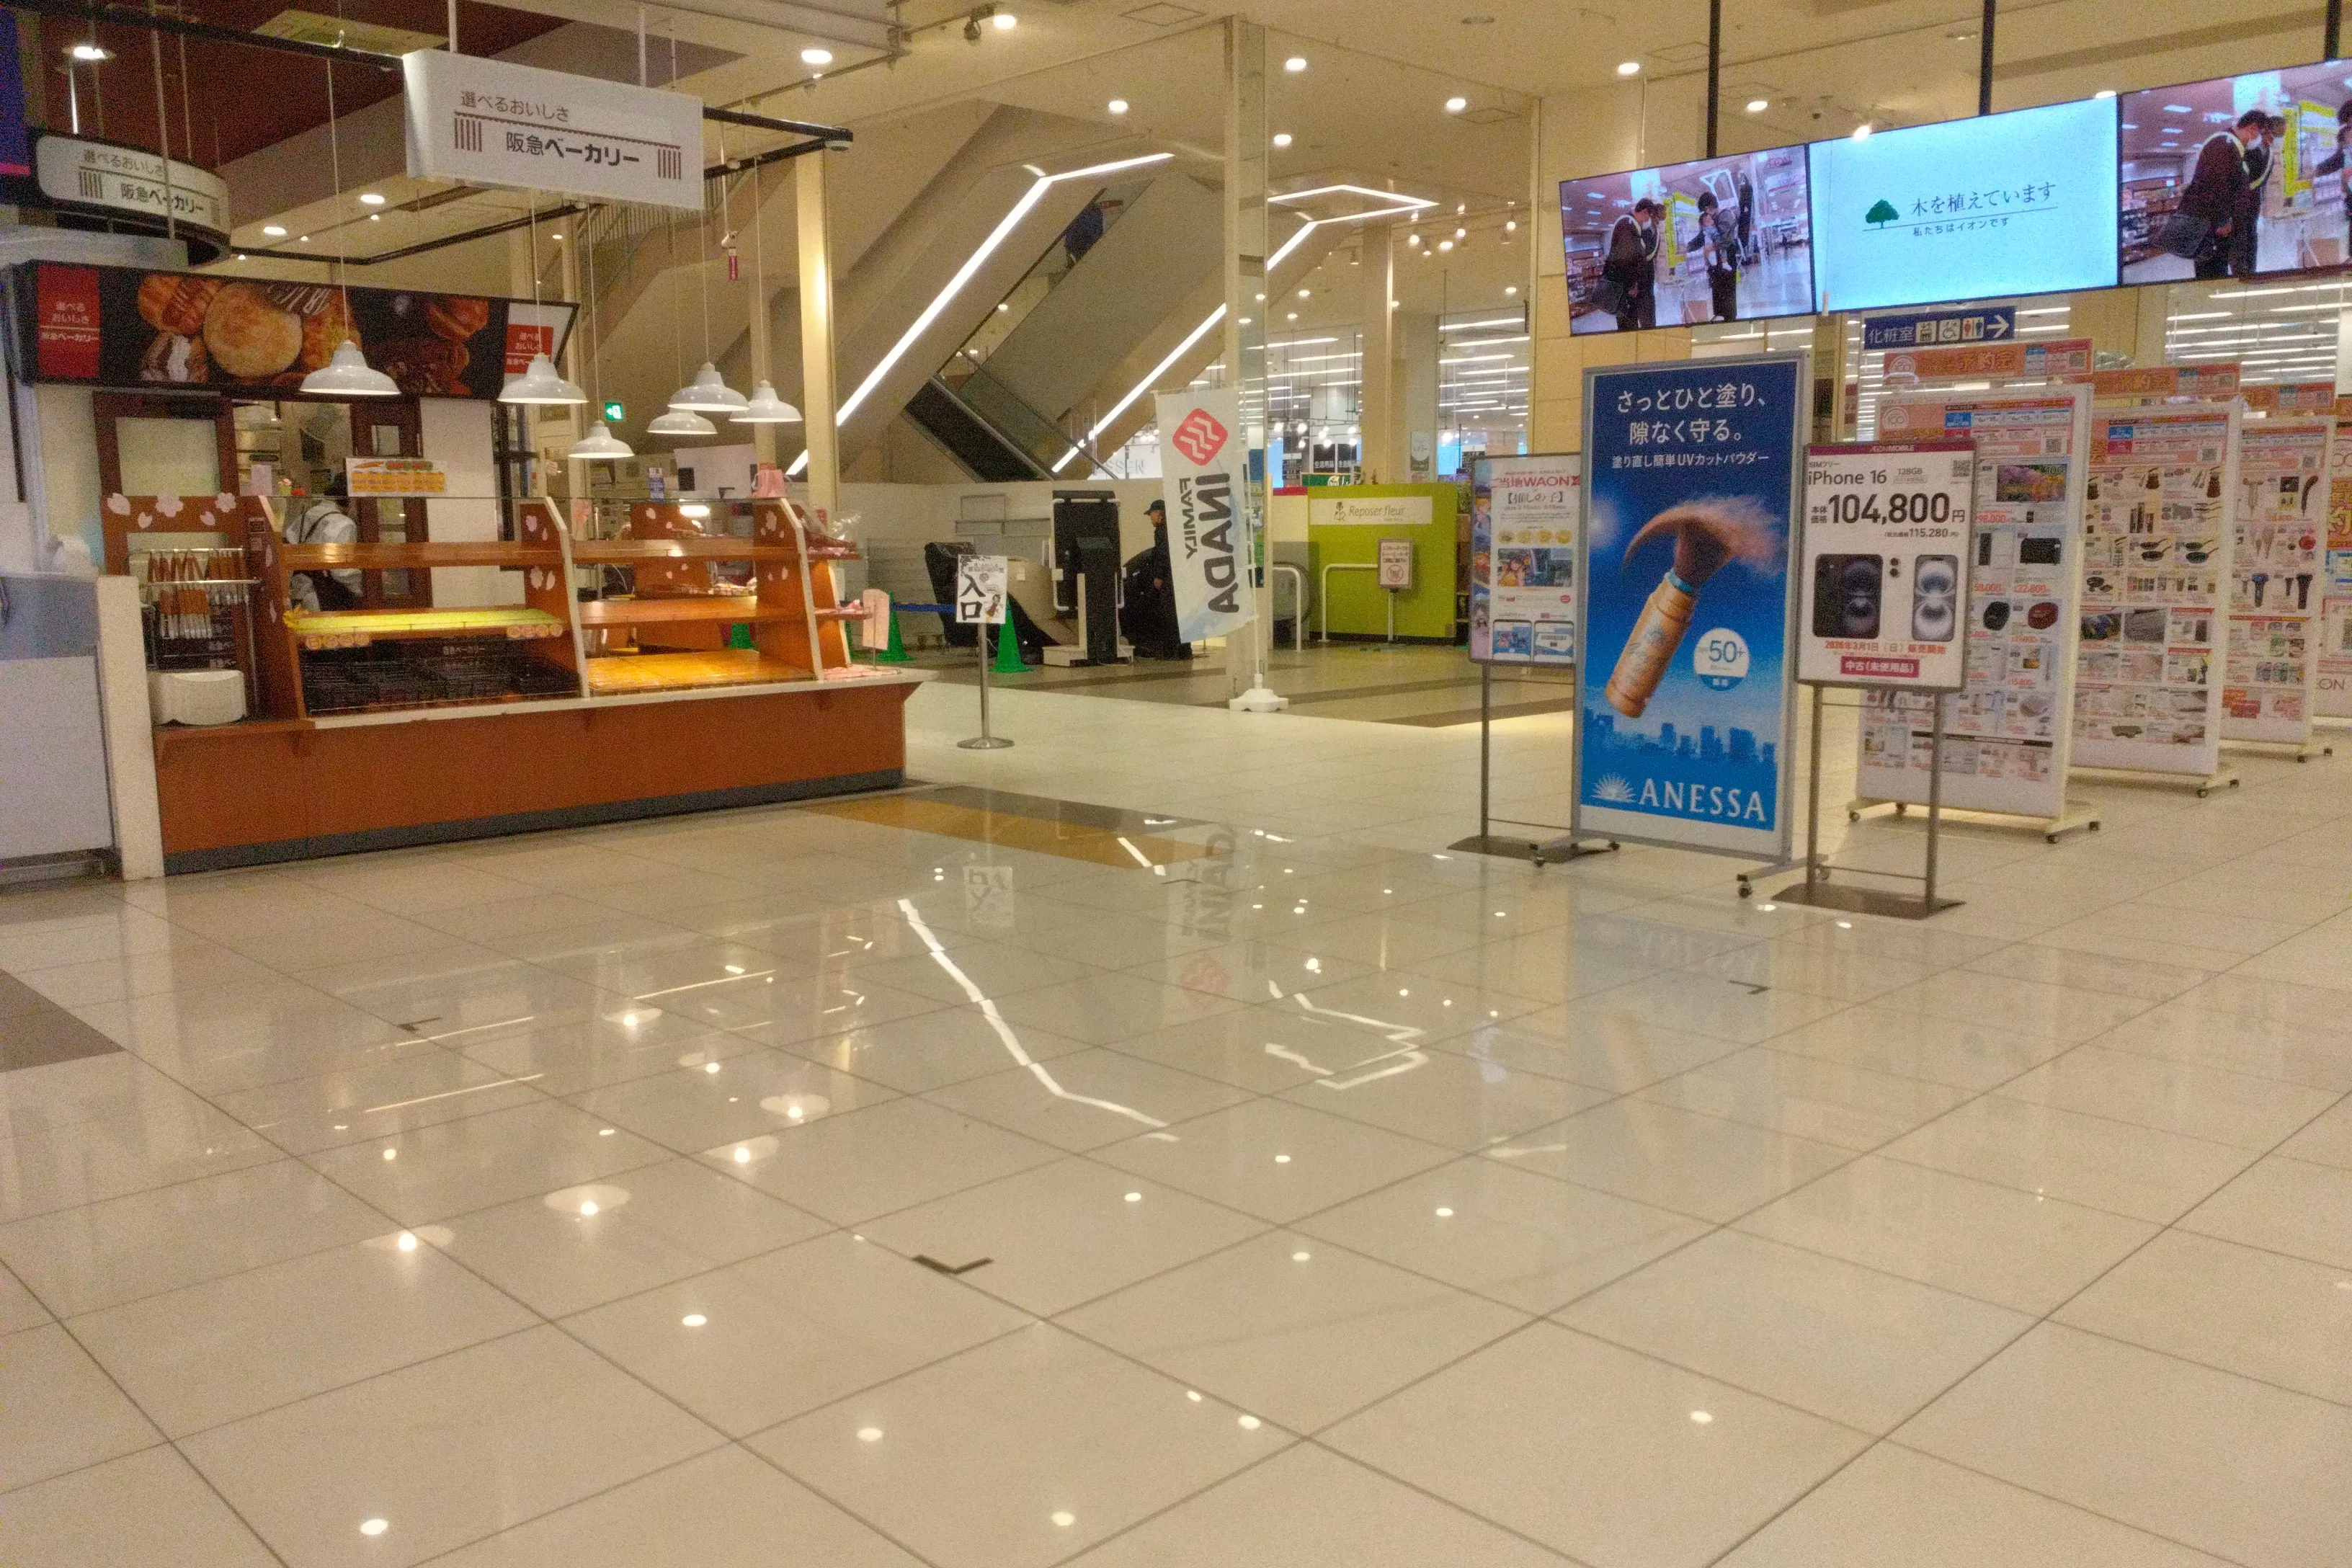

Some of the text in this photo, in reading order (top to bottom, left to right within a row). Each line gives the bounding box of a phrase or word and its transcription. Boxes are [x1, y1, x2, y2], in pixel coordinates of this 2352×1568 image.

[461, 91, 569, 122] 選べるおいしさ
[507, 131, 640, 166] 阪急ベーカリー
[1912, 182, 2056, 216] 木を植えています
[1913, 217, 2009, 236] 私たちはイオンです
[1868, 326, 1914, 344] 化粧室
[1617, 383, 1766, 413] さっとひと塗り、
[1629, 419, 1742, 445] 隙なく守る。
[1808, 470, 1864, 485] iPhone
[1870, 469, 1887, 484] 16
[1897, 467, 1923, 476] 128GB
[1349, 504, 1406, 518] Reposer fleur
[959, 574, 986, 620] 入口
[1639, 778, 1768, 821] ANESSA
